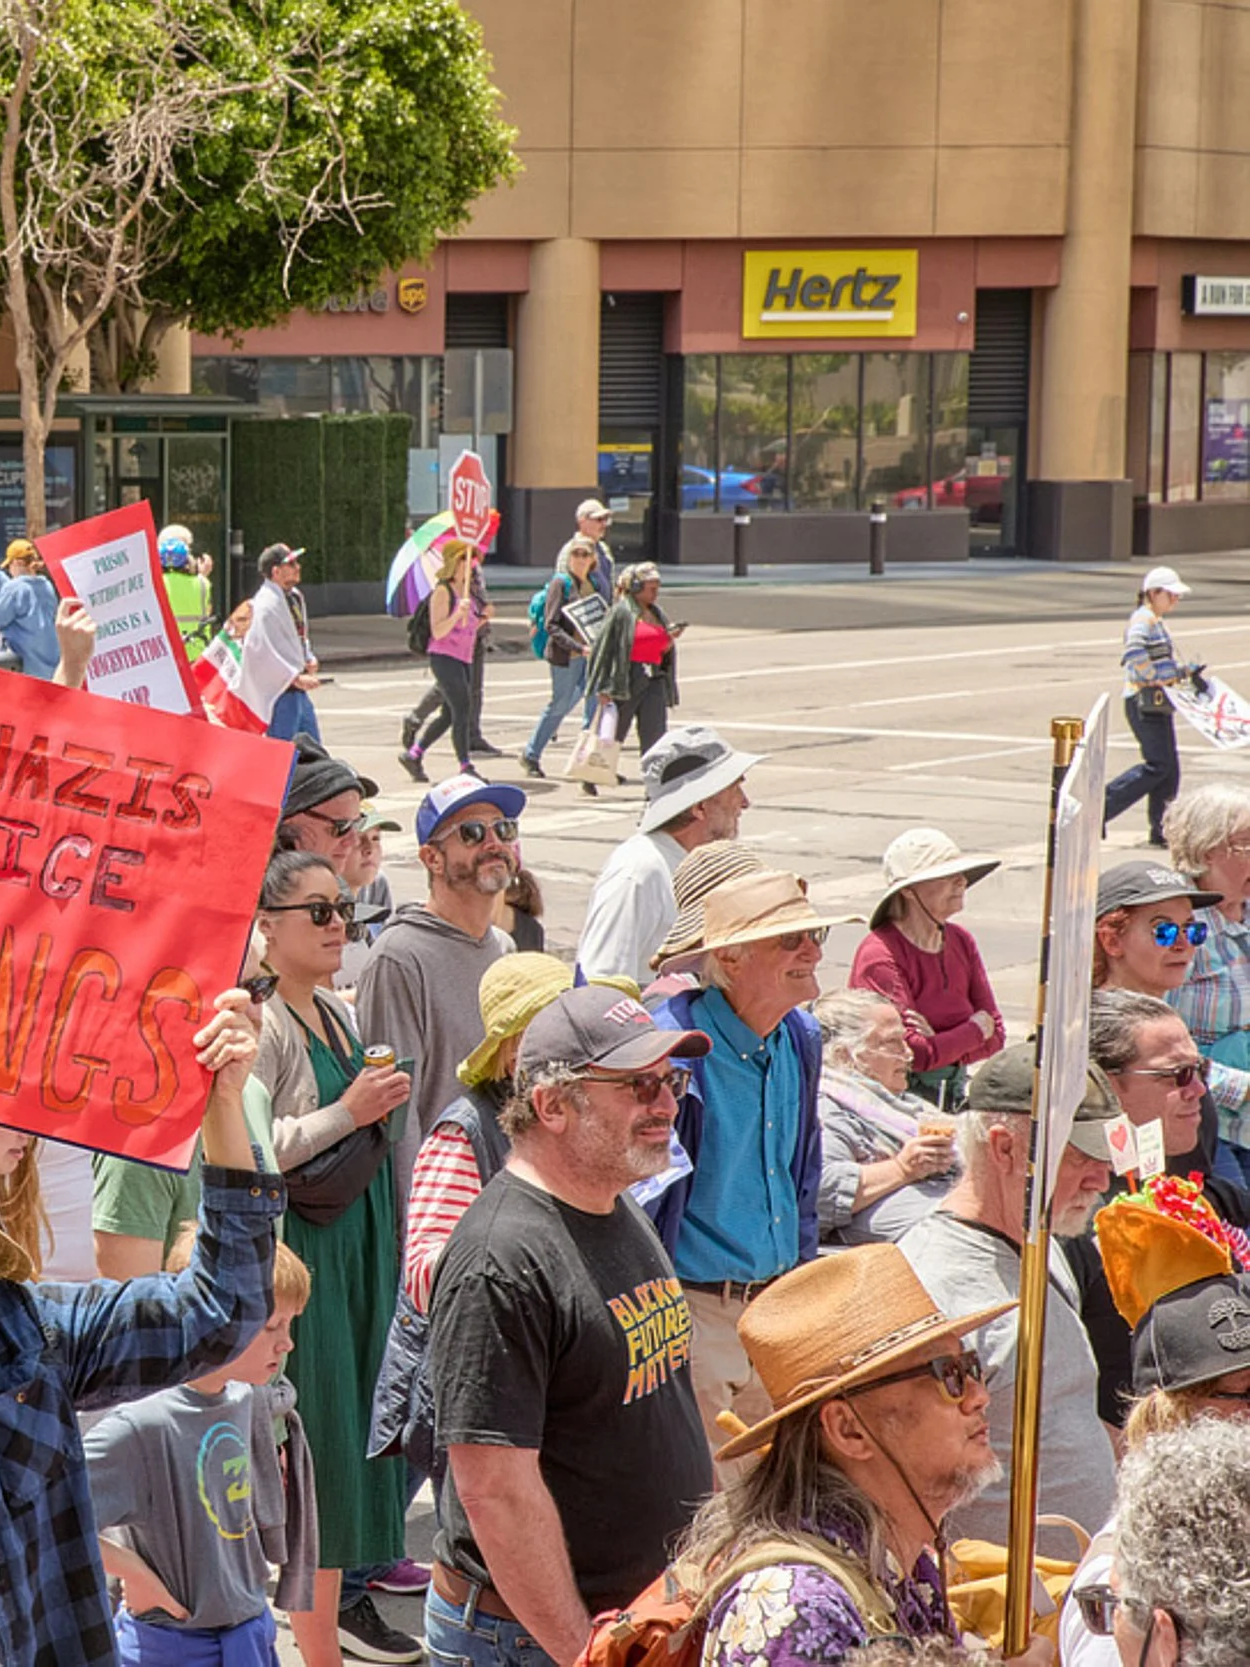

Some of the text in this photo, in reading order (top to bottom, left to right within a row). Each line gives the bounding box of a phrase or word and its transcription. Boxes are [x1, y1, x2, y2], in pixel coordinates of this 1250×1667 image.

[762, 267, 902, 310] Hertz
[455, 476, 491, 520] STOP
[93, 548, 129, 575] PRISON
